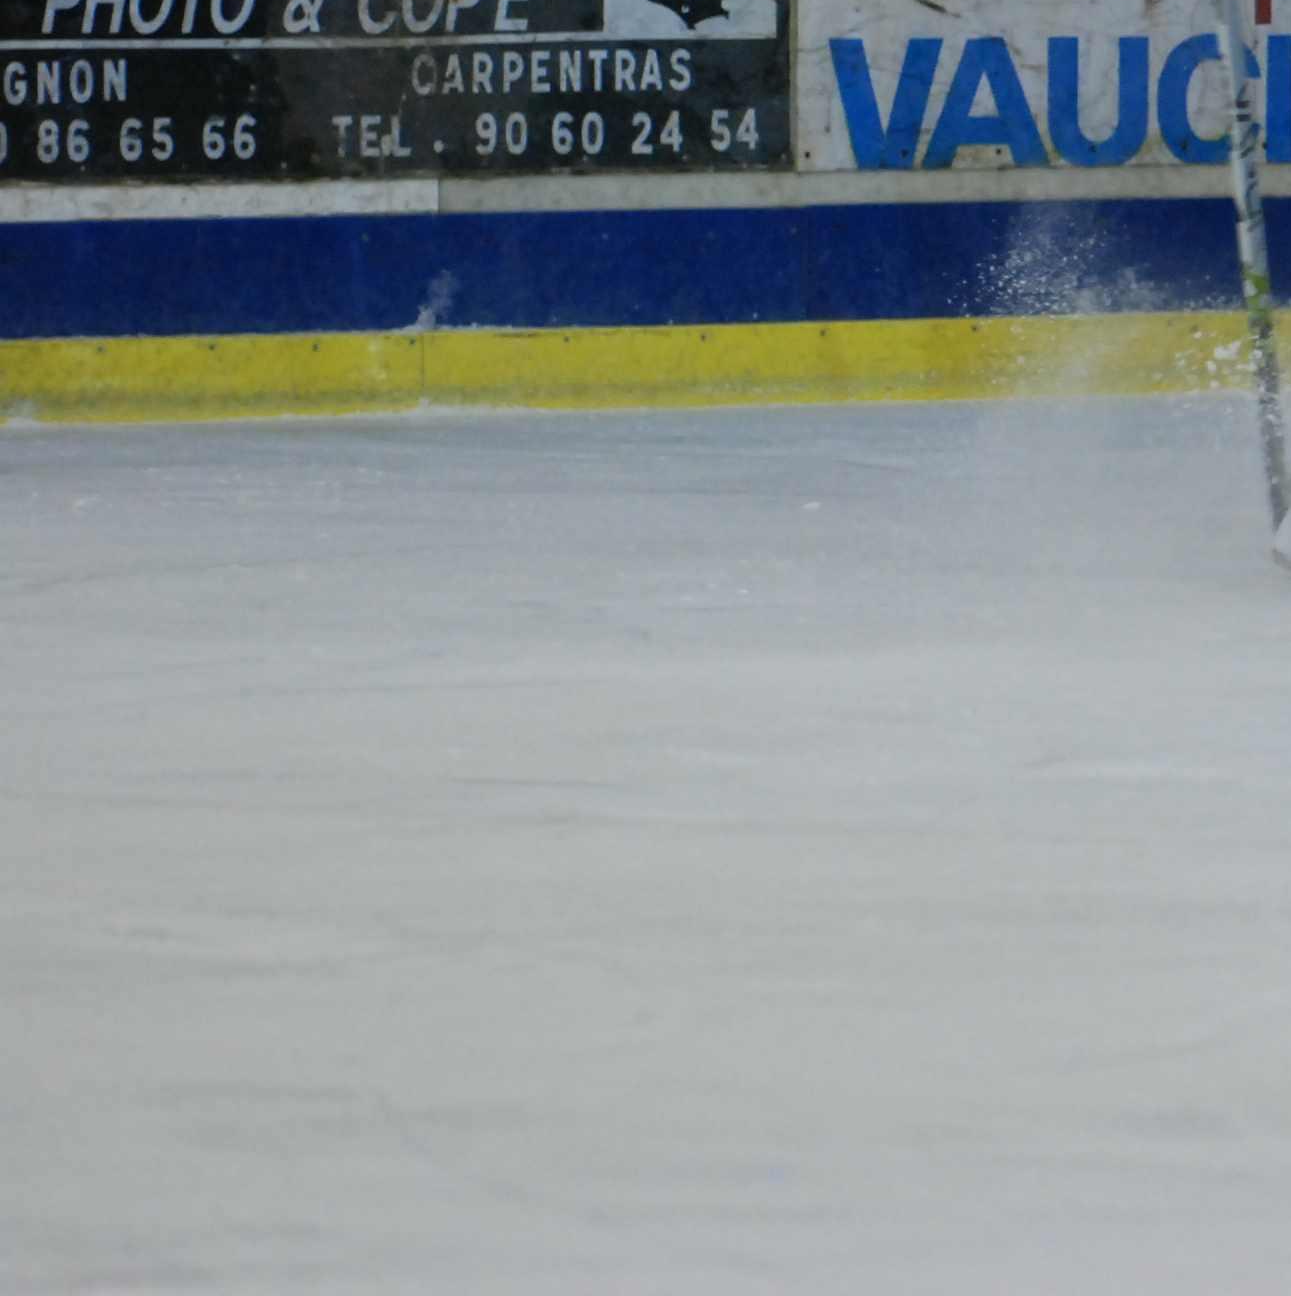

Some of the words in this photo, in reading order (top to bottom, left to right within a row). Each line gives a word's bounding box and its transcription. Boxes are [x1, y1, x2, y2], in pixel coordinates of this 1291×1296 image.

[3, 58, 128, 106] GNON
[411, 48, 692, 95] CARPENTRAS
[37, 119, 91, 164] 86
[119, 116, 174, 162] 65
[202, 112, 257, 161] 66
[475, 111, 529, 155] 90
[551, 111, 605, 155] 60
[631, 110, 683, 155] 24
[710, 108, 760, 152] 54
